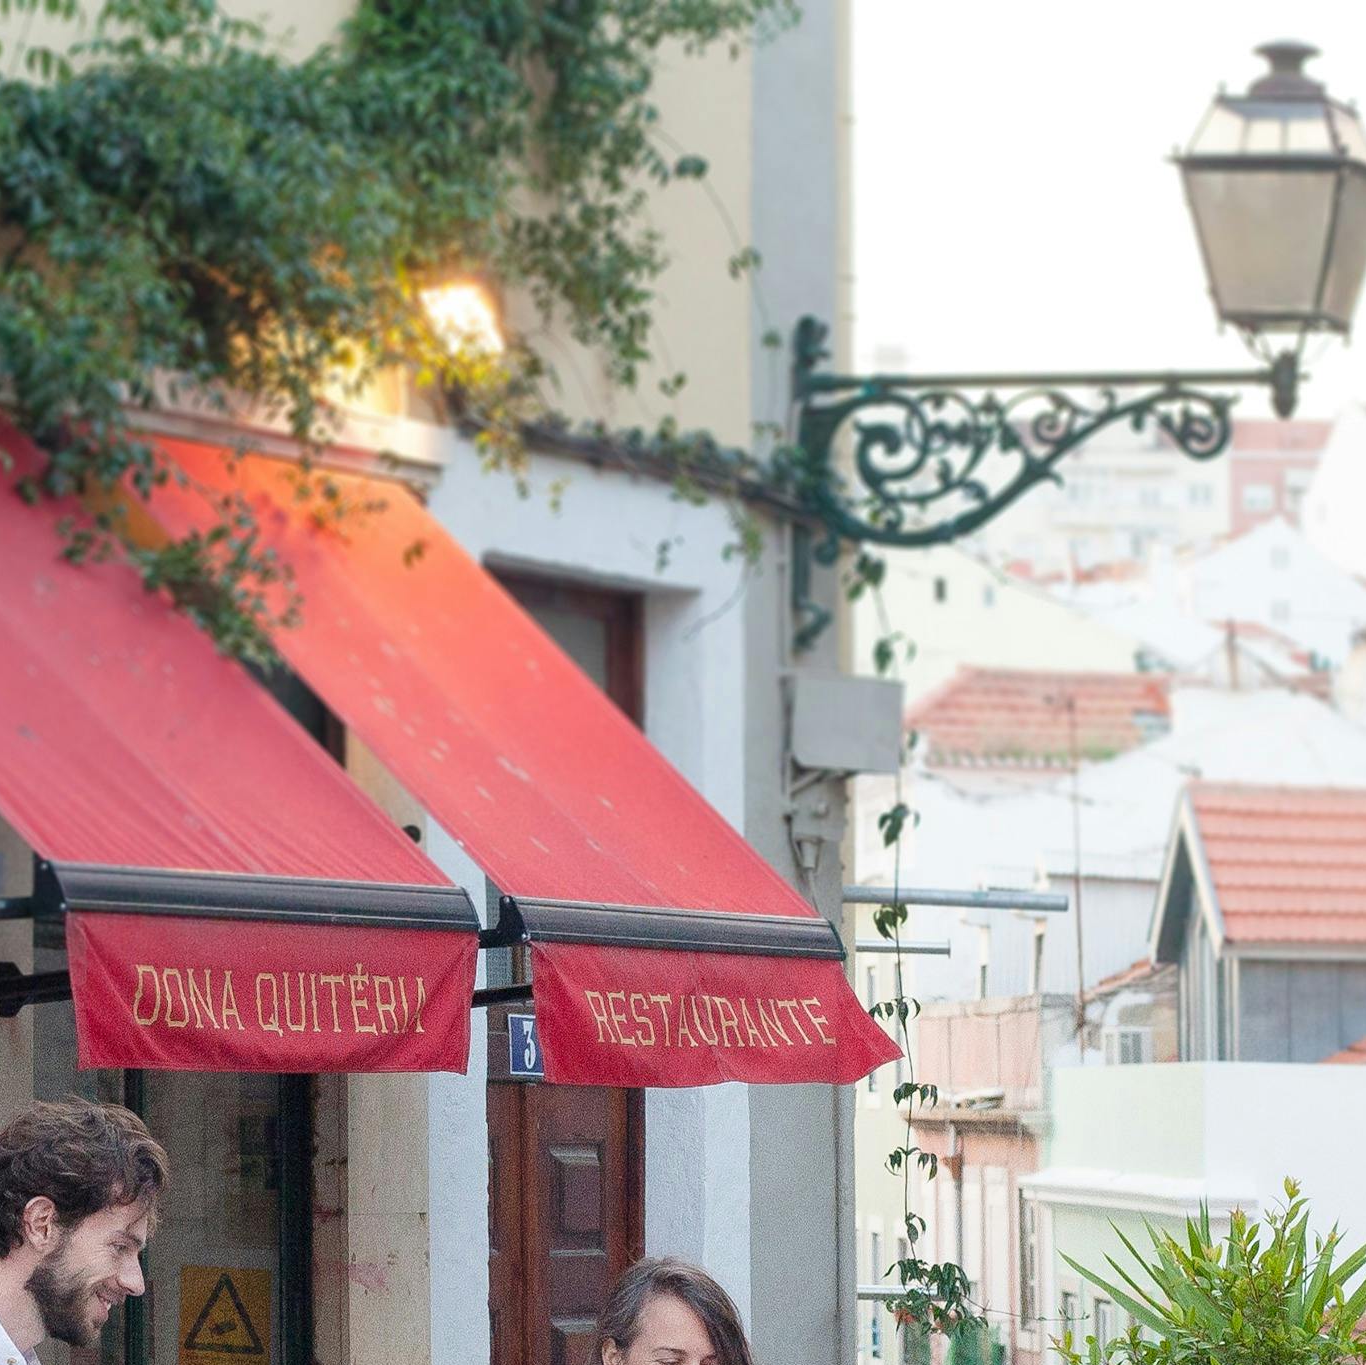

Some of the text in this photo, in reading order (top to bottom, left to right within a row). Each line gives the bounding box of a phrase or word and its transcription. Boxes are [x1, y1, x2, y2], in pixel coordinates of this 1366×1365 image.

[133, 962, 427, 1037] DONA QUITÉRIA
[584, 990, 837, 1048] RESTAURANTE
